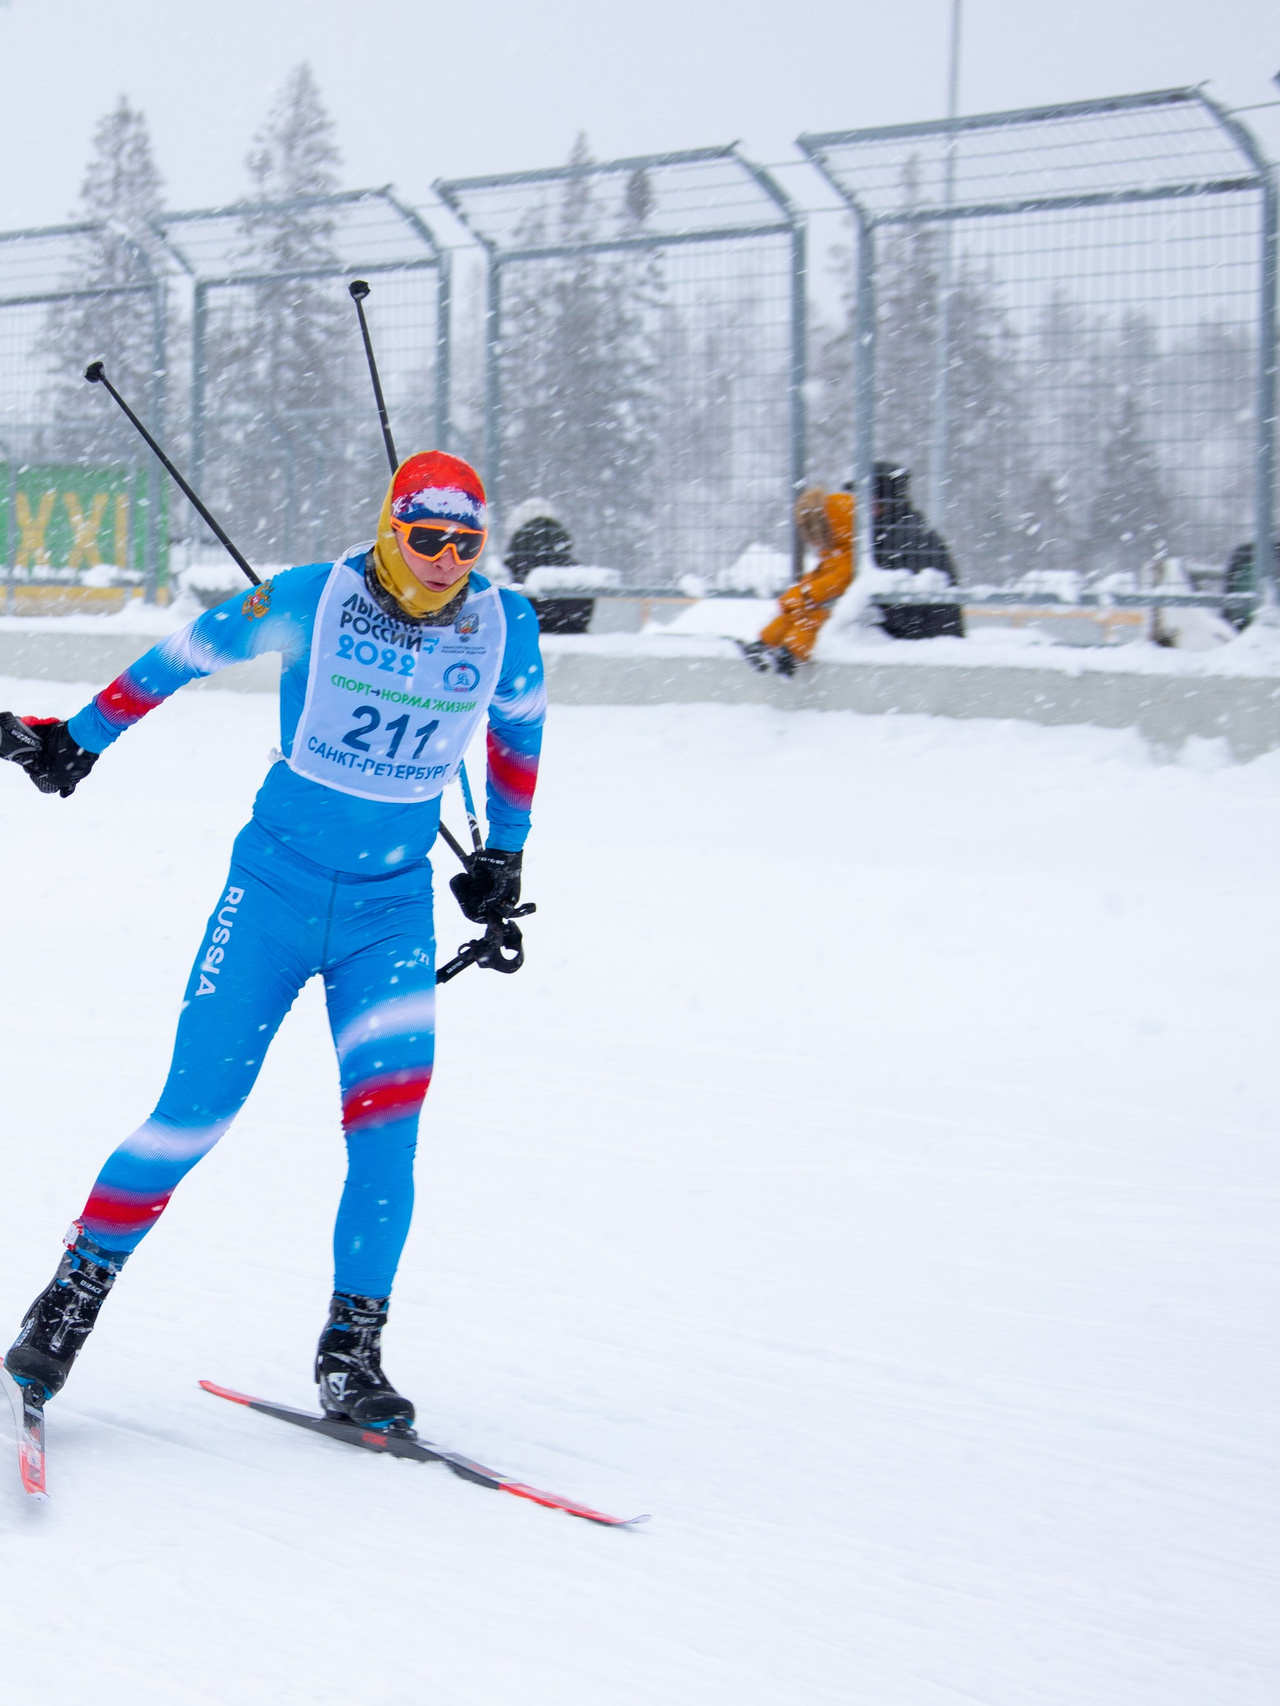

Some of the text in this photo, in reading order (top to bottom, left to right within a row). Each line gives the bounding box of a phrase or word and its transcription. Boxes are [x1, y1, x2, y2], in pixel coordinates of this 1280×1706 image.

[340, 610, 423, 652] РОССИИ
[335, 634, 415, 677] 2022
[331, 674, 477, 714] СПОРТ НОРМА ЖИЗНИ
[341, 705, 440, 760] 211
[307, 736, 450, 780] САНКТ-ПЕТЕРБУРГ
[195, 886, 245, 997] RUSSIA
